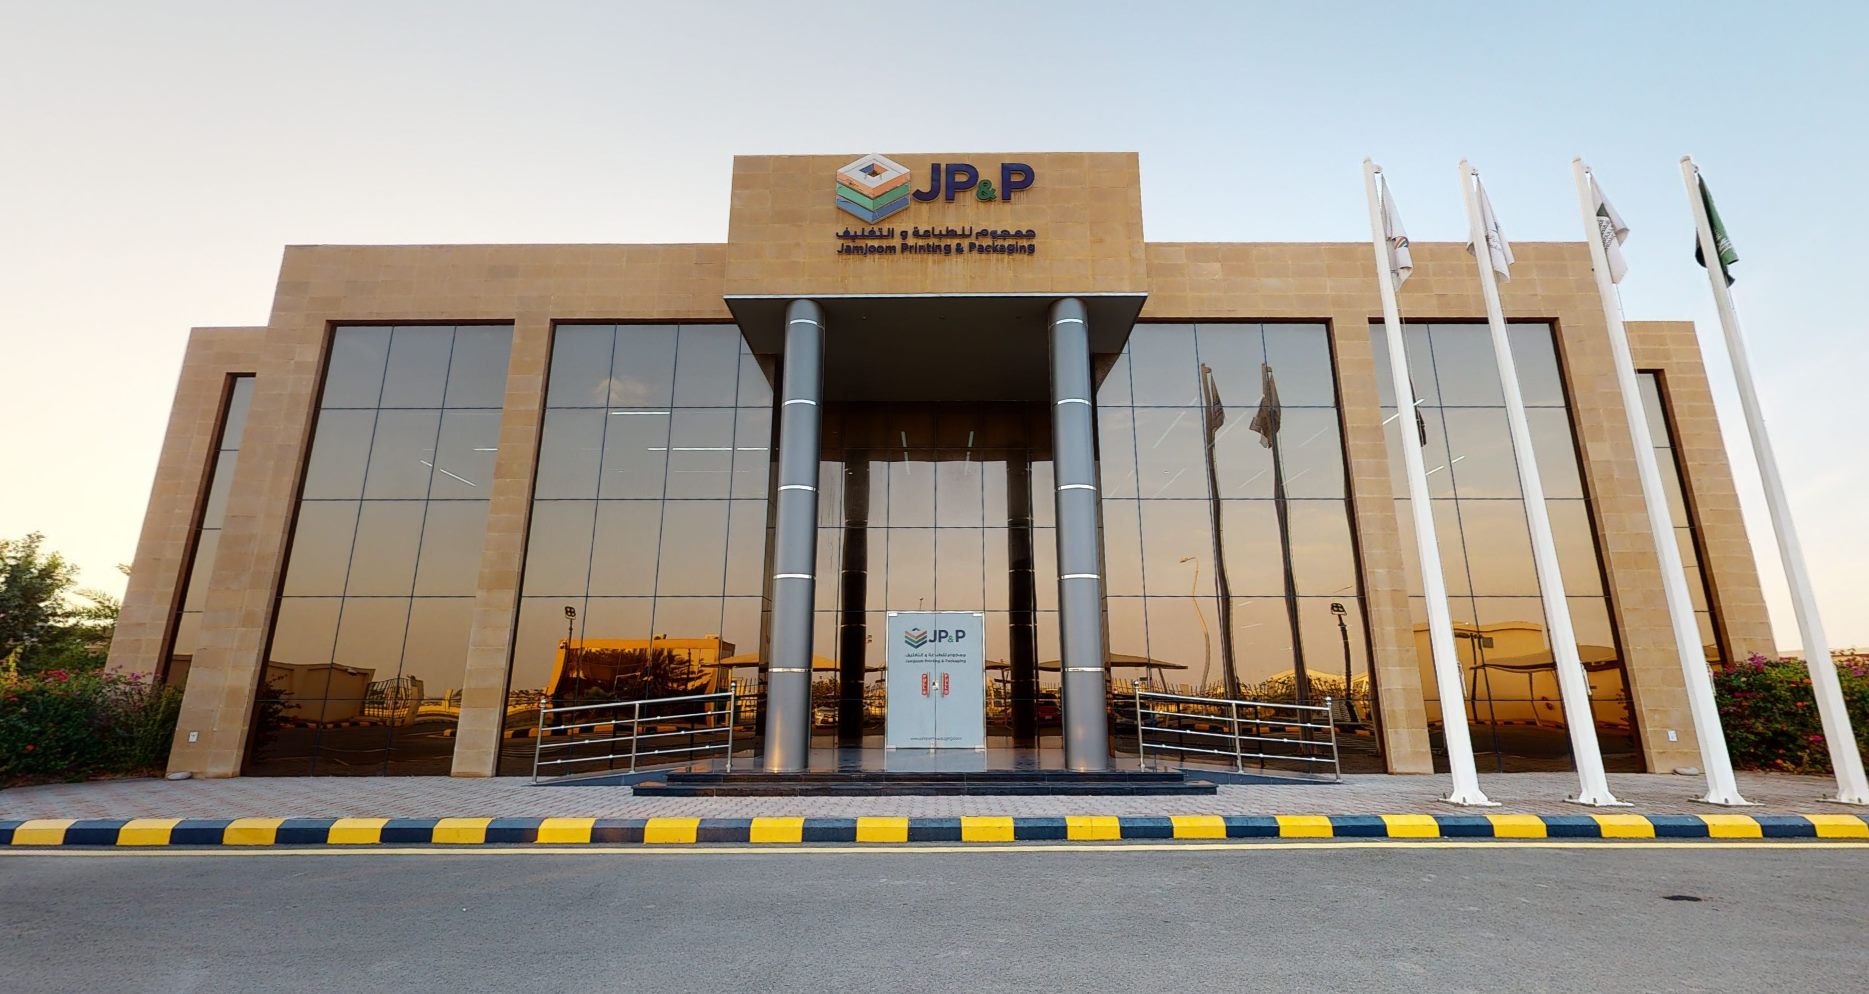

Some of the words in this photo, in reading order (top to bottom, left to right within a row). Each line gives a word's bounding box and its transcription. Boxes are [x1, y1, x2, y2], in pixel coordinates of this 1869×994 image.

[912, 162, 1036, 203] JP&P
[835, 226, 895, 242] التغليف
[900, 230, 909, 240] و
[912, 226, 972, 241] للطباعة
[976, 228, 1036, 241] جمجوم
[836, 242, 897, 257] Jamjoom
[901, 242, 952, 256] Printing
[955, 242, 965, 254] &
[968, 241, 1036, 256] Packaging
[928, 629, 966, 643] JP&P
